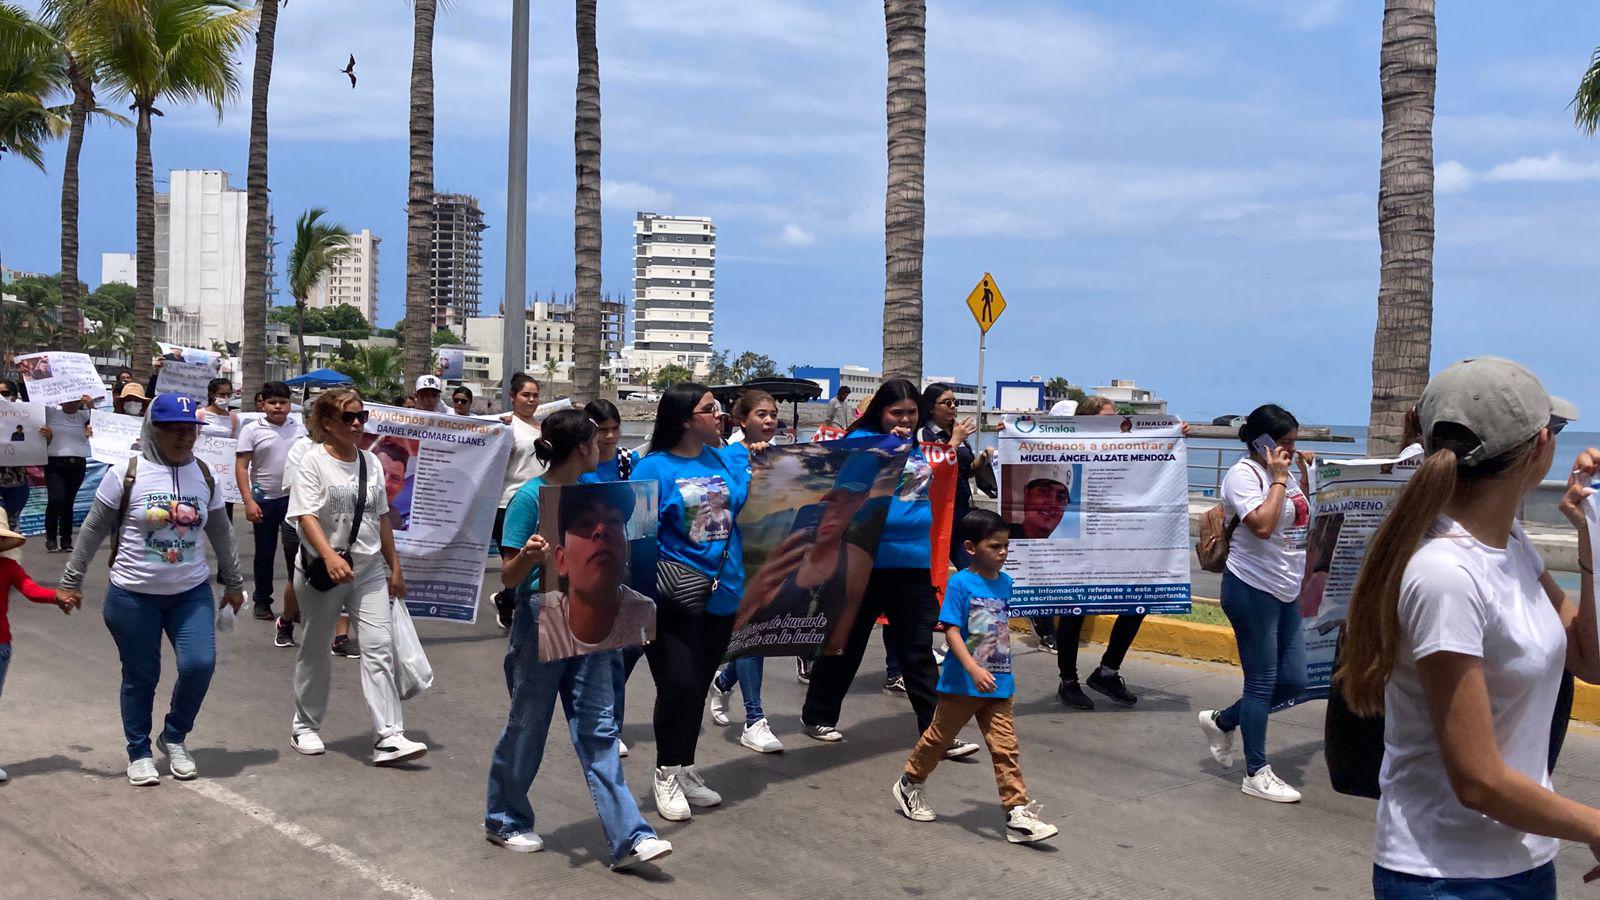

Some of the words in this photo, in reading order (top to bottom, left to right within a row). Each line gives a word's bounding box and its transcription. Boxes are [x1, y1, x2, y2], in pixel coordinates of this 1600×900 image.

[177, 397, 190, 412] T
[428, 418, 434, 426] a
[438, 420, 488, 434] encontrar
[493, 428, 499, 436] a
[1039, 424, 1076, 433] Sinaloa
[377, 425, 406, 436] DANIEL
[407, 429, 456, 443] PALOMARES
[457, 436, 486, 447] LLANES
[1090, 443, 1097, 451] a
[1101, 441, 1163, 451] encontrar
[1167, 442, 1174, 450] a
[1020, 454, 1057, 463] MIGUEL
[1059, 452, 1091, 462] ÁNGEL
[1092, 453, 1129, 462] ALZATE
[1130, 453, 1176, 462] MENDOZA
[147, 494, 168, 502] Jose
[170, 494, 198, 502] Manuel
[1319, 504, 1339, 513] ALAN
[1341, 501, 1383, 511] MORENO
[1088, 594, 1112, 602] ayuda
[1145, 592, 1189, 600] importante.
[778, 629, 792, 644] la
[792, 628, 825, 644] lucha
